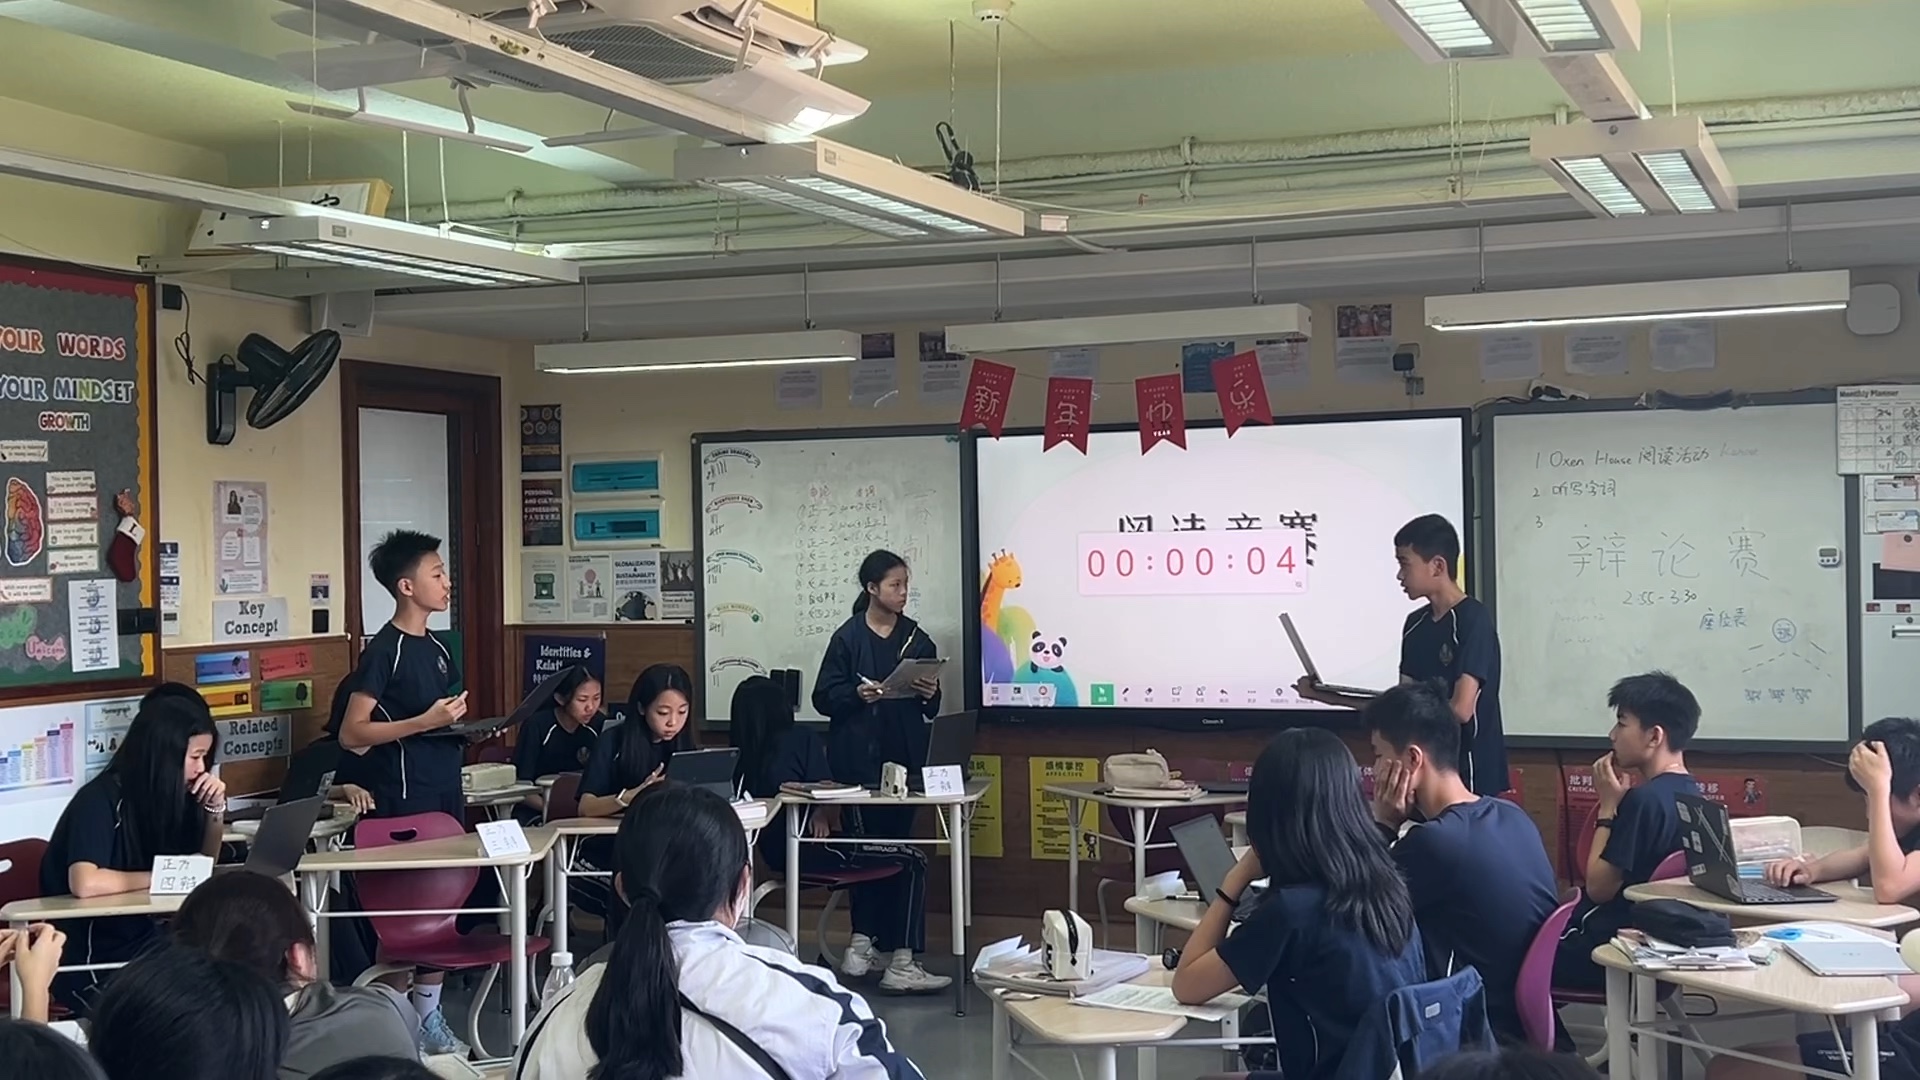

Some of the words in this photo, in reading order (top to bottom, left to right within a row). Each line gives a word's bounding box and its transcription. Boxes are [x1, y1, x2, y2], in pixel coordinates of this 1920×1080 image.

[0, 327, 43, 353] OUR
[58, 333, 126, 360] WORDS
[55, 378, 134, 403] MINDSET
[1840, 389, 1869, 399] Monthly
[1870, 389, 1899, 397] Planner
[974, 385, 1001, 416] 新
[1054, 401, 1079, 431] 年
[1146, 400, 1173, 428] 快
[1230, 379, 1256, 410] 乐
[40, 413, 89, 431] GROWTH
[1153, 429, 1171, 437] YEAR
[1549, 451, 1584, 468] Oxen
[1594, 450, 1632, 466] House
[1638, 445, 1709, 466] 阅读活动
[1532, 487, 1541, 498] 2
[1552, 478, 1617, 497] 听写字词
[1535, 516, 1544, 529] 3
[615, 560, 656, 568] GLOBALIZATION
[1087, 545, 1297, 577] 00:00:04
[238, 600, 266, 619] Key
[224, 618, 278, 637] Concept
[540, 645, 582, 658] Identities
[583, 647, 592, 659] &
[536, 660, 563, 671] Relat
[229, 717, 278, 736] Related
[223, 738, 283, 756] Concepts
